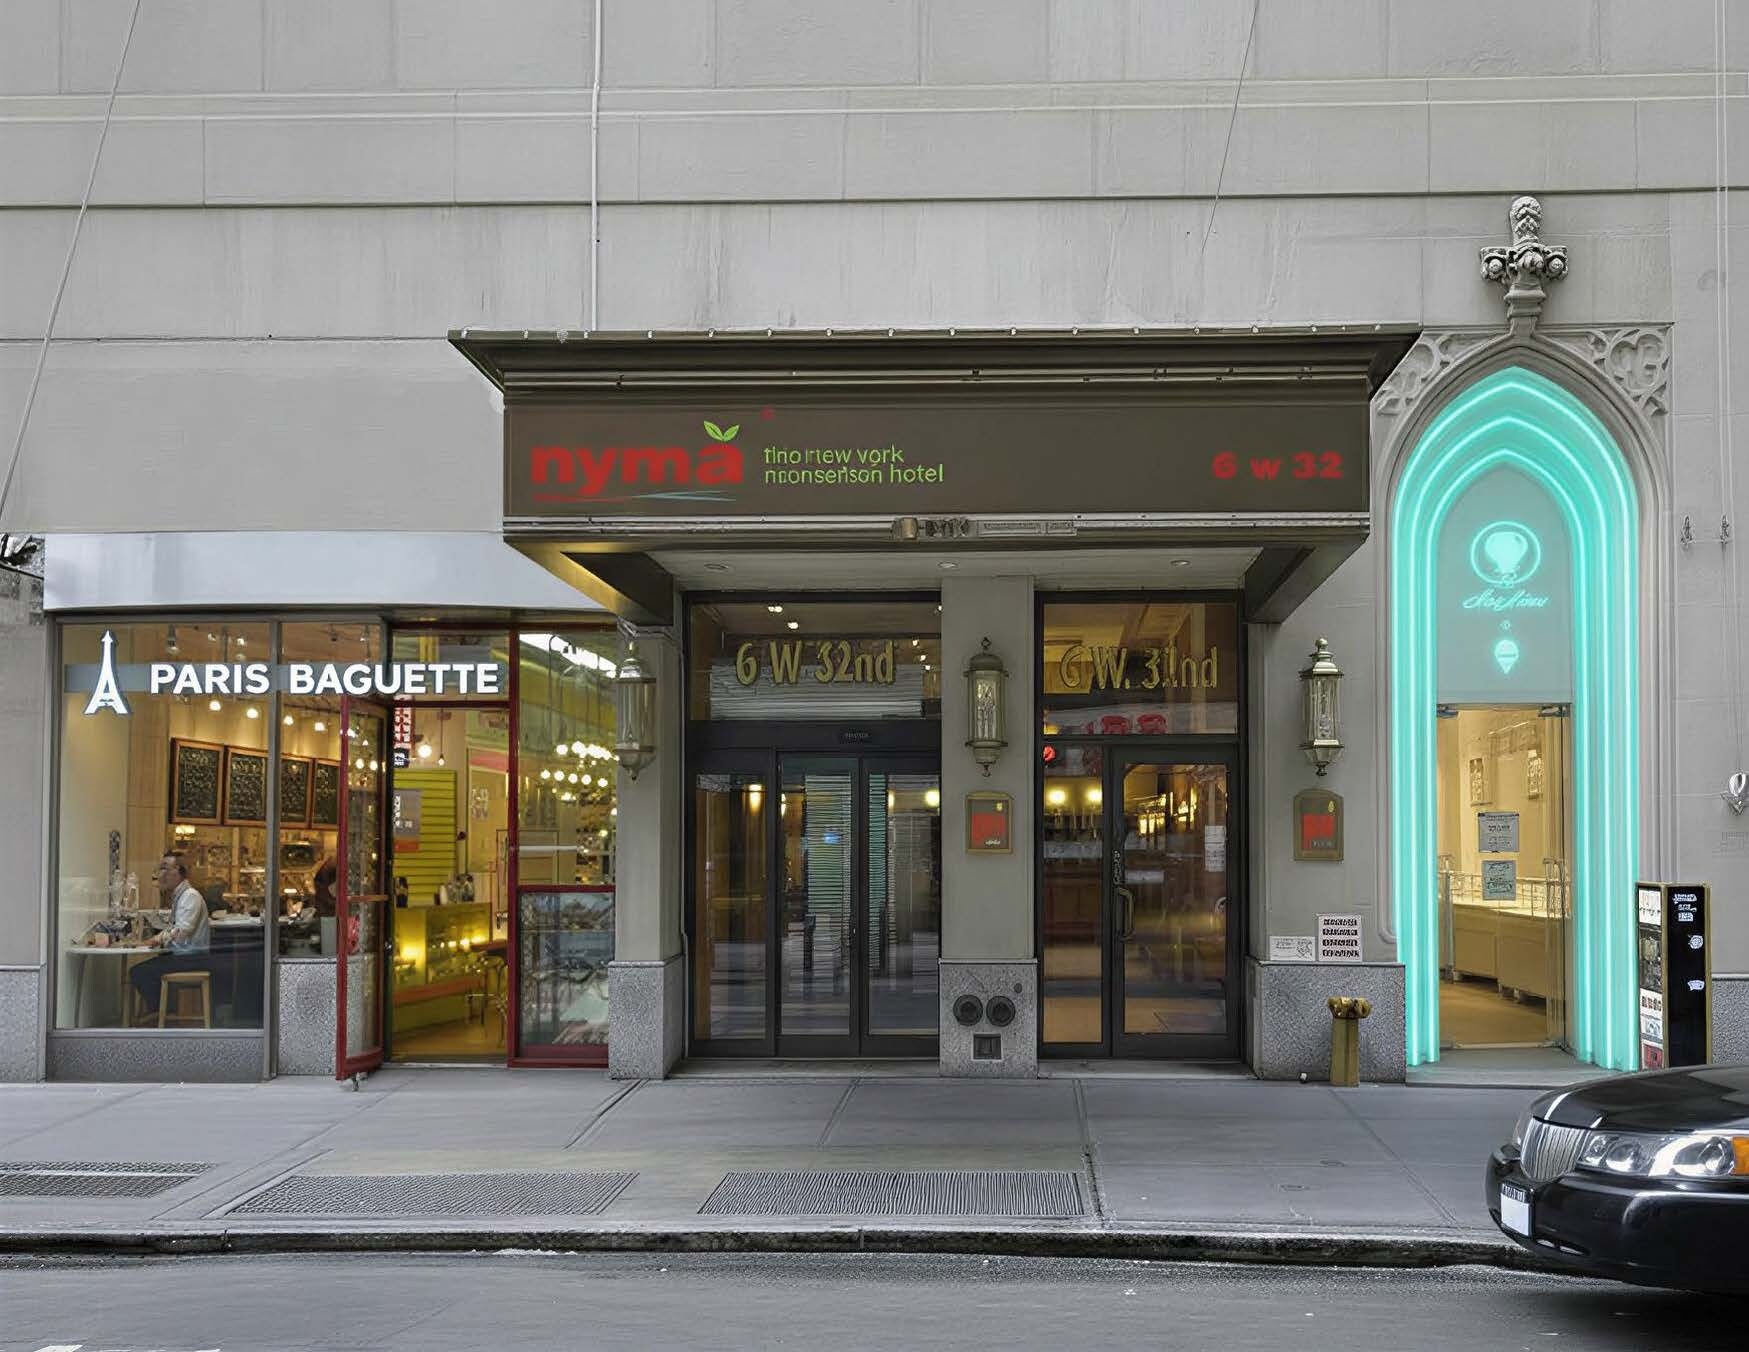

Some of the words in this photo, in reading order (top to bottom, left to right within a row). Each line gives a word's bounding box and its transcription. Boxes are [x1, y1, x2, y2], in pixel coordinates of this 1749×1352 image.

[532, 444, 743, 495] nyma
[890, 464, 943, 483] hotel
[1212, 452, 1237, 480] 6
[1292, 452, 1343, 480] 32
[736, 643, 758, 686] 6
[769, 640, 802, 684] W
[815, 640, 895, 684] 32nd
[150, 664, 270, 694] PARIS
[290, 664, 499, 694] BAGUETTE
